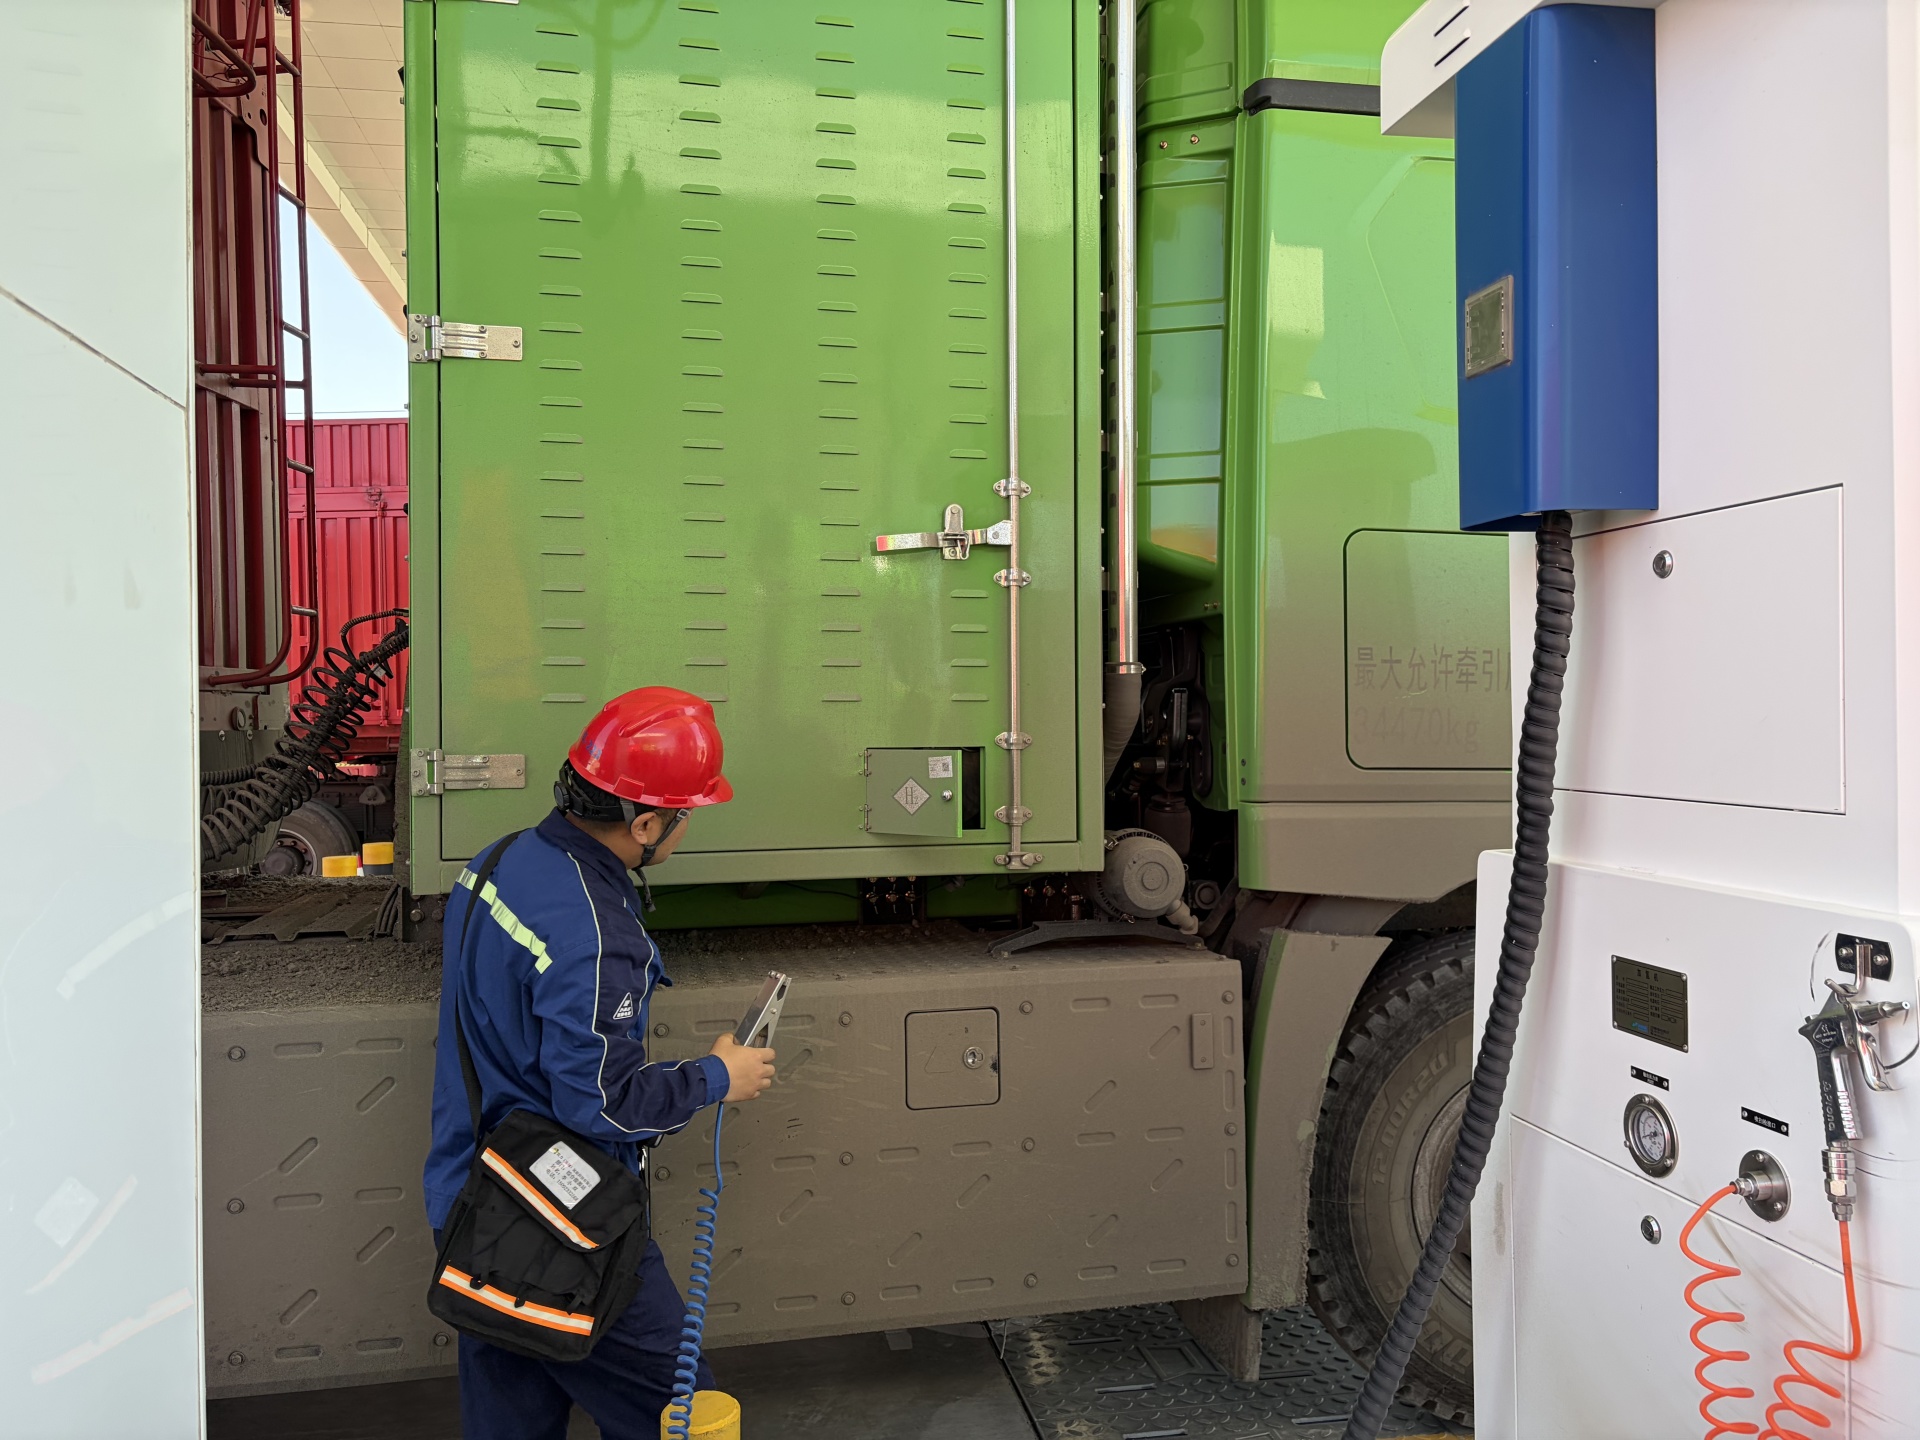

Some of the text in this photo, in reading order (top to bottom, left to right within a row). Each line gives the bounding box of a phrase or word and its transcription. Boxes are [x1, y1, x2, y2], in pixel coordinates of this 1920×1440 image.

[1354, 643, 1511, 693] 最大允许牵引
